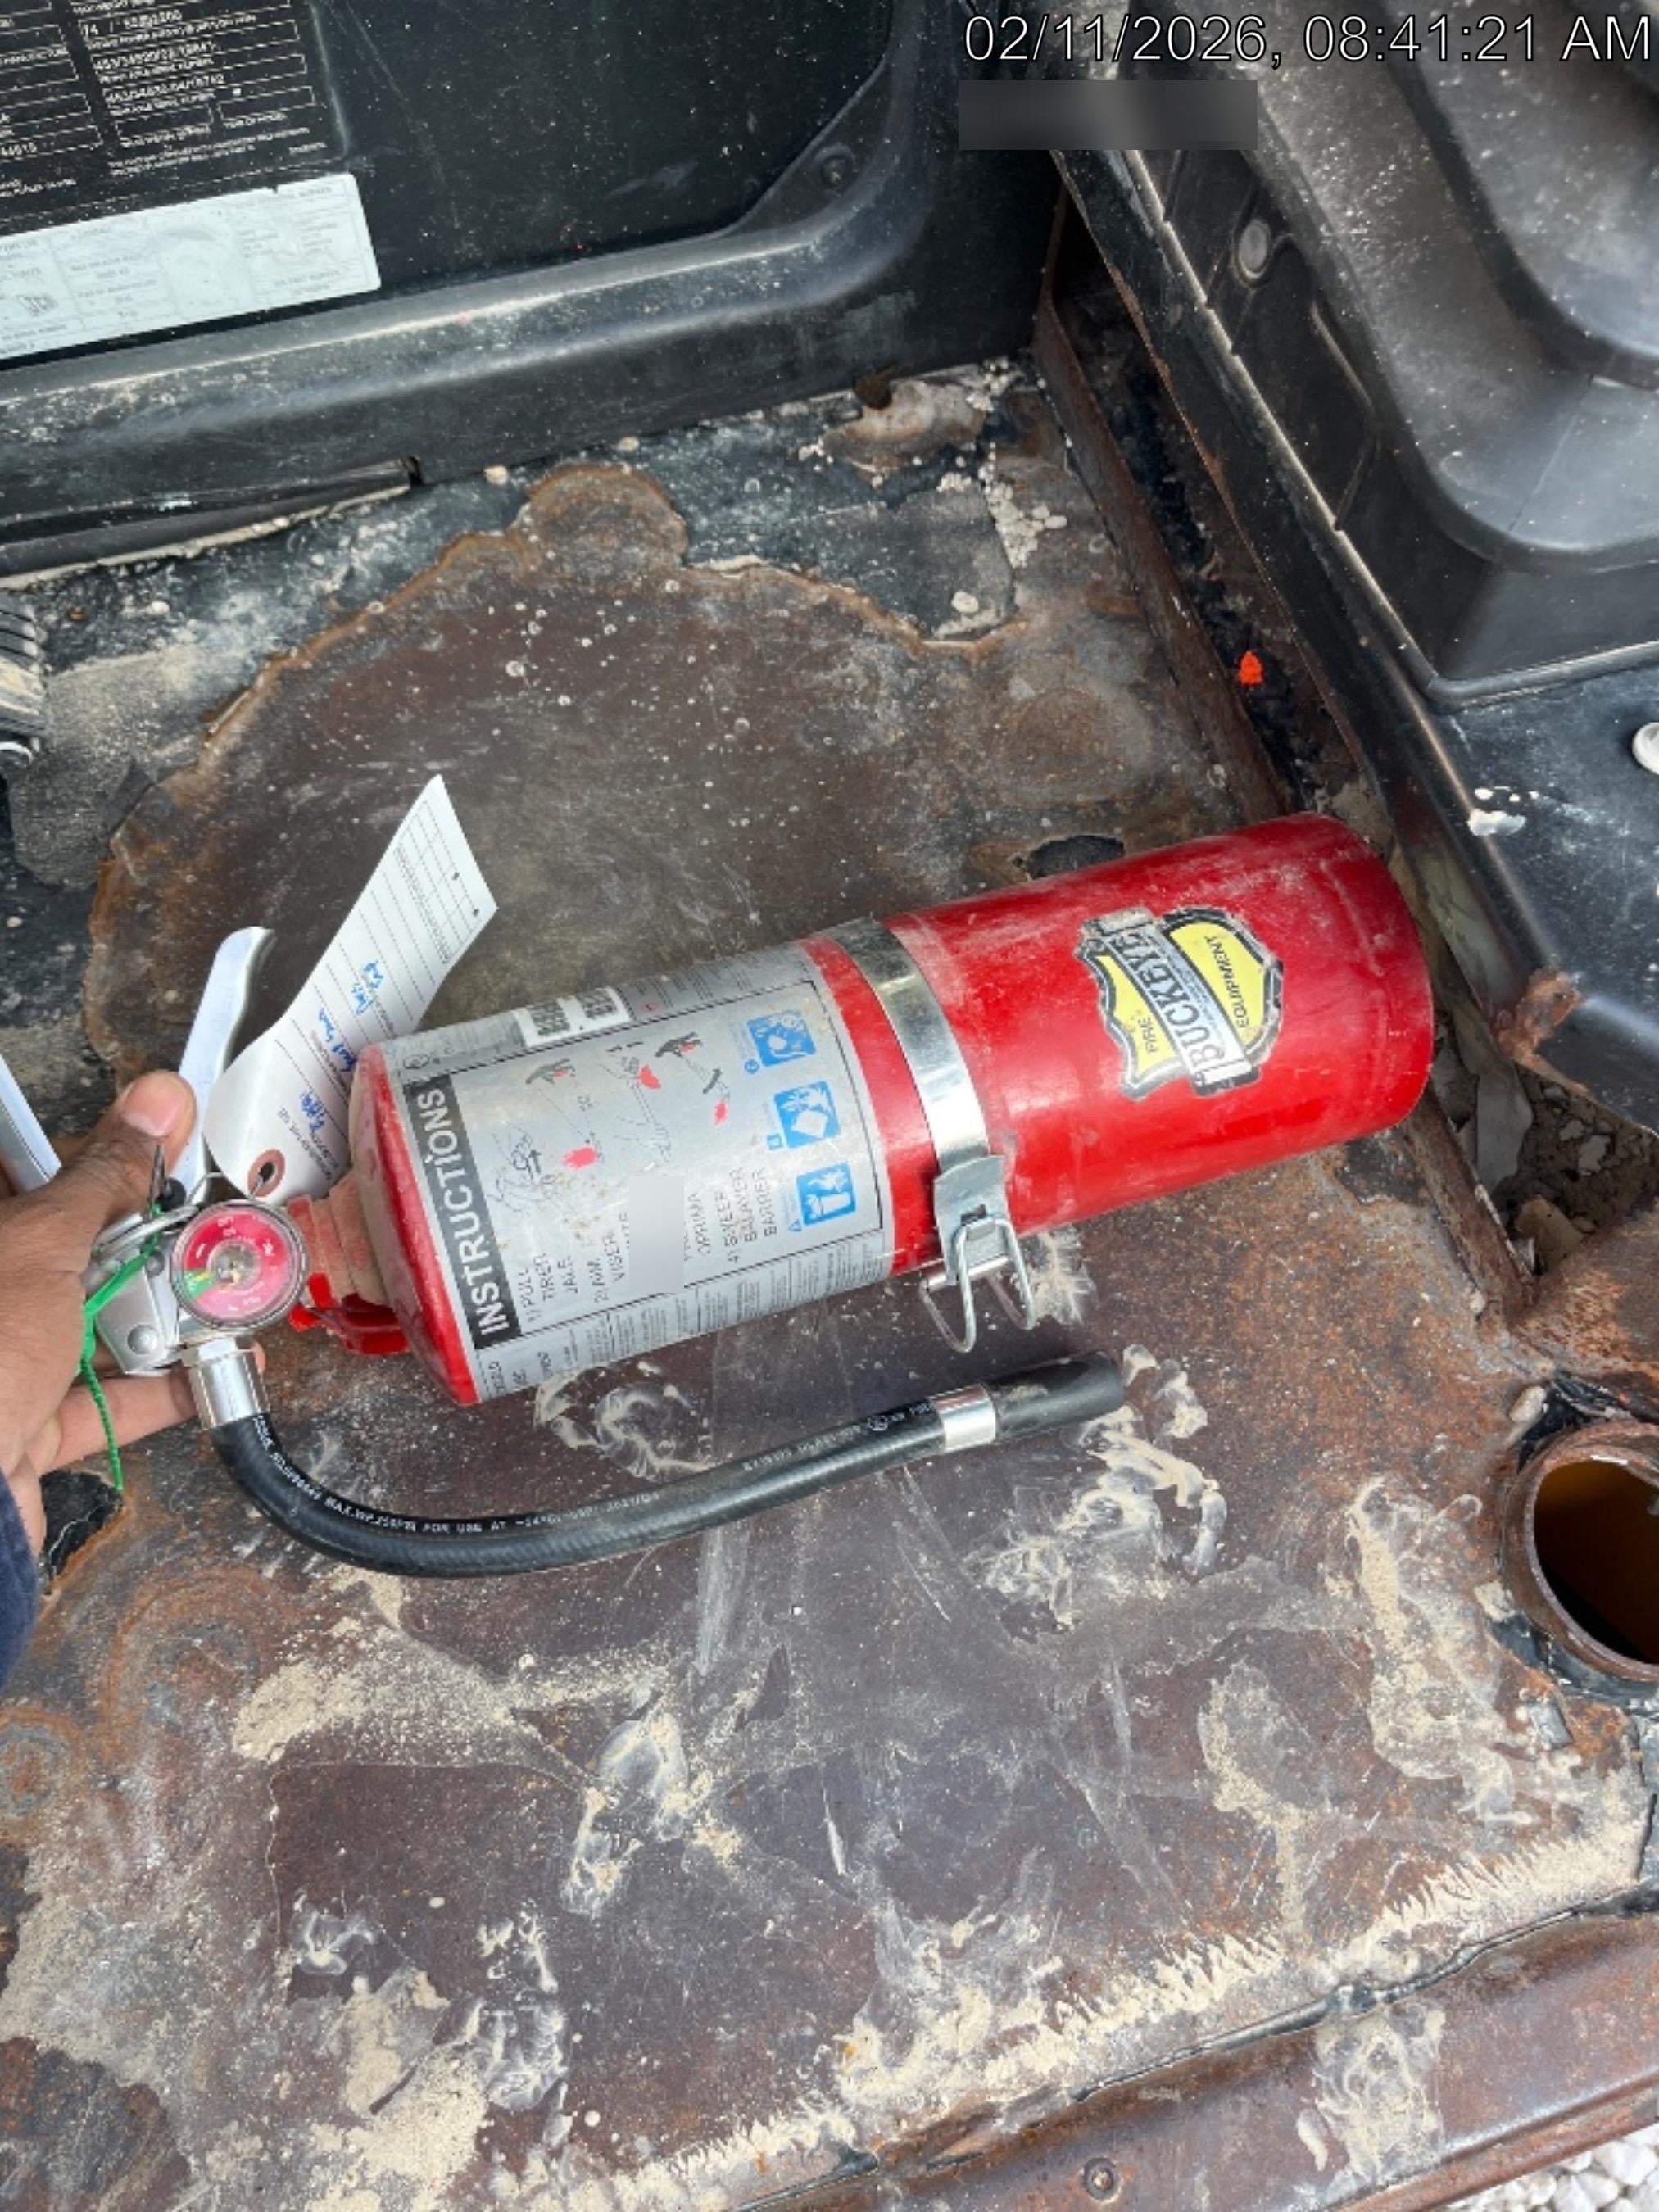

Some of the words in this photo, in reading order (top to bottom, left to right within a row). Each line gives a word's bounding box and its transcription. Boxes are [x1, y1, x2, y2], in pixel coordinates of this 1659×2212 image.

[1108, 930, 1226, 1068] BUCKEYE
[1138, 1017, 1158, 1054] FIRE
[1204, 935, 1249, 1028] EQUIPMENT
[418, 1087, 510, 1335] INSTRUCTIONS
